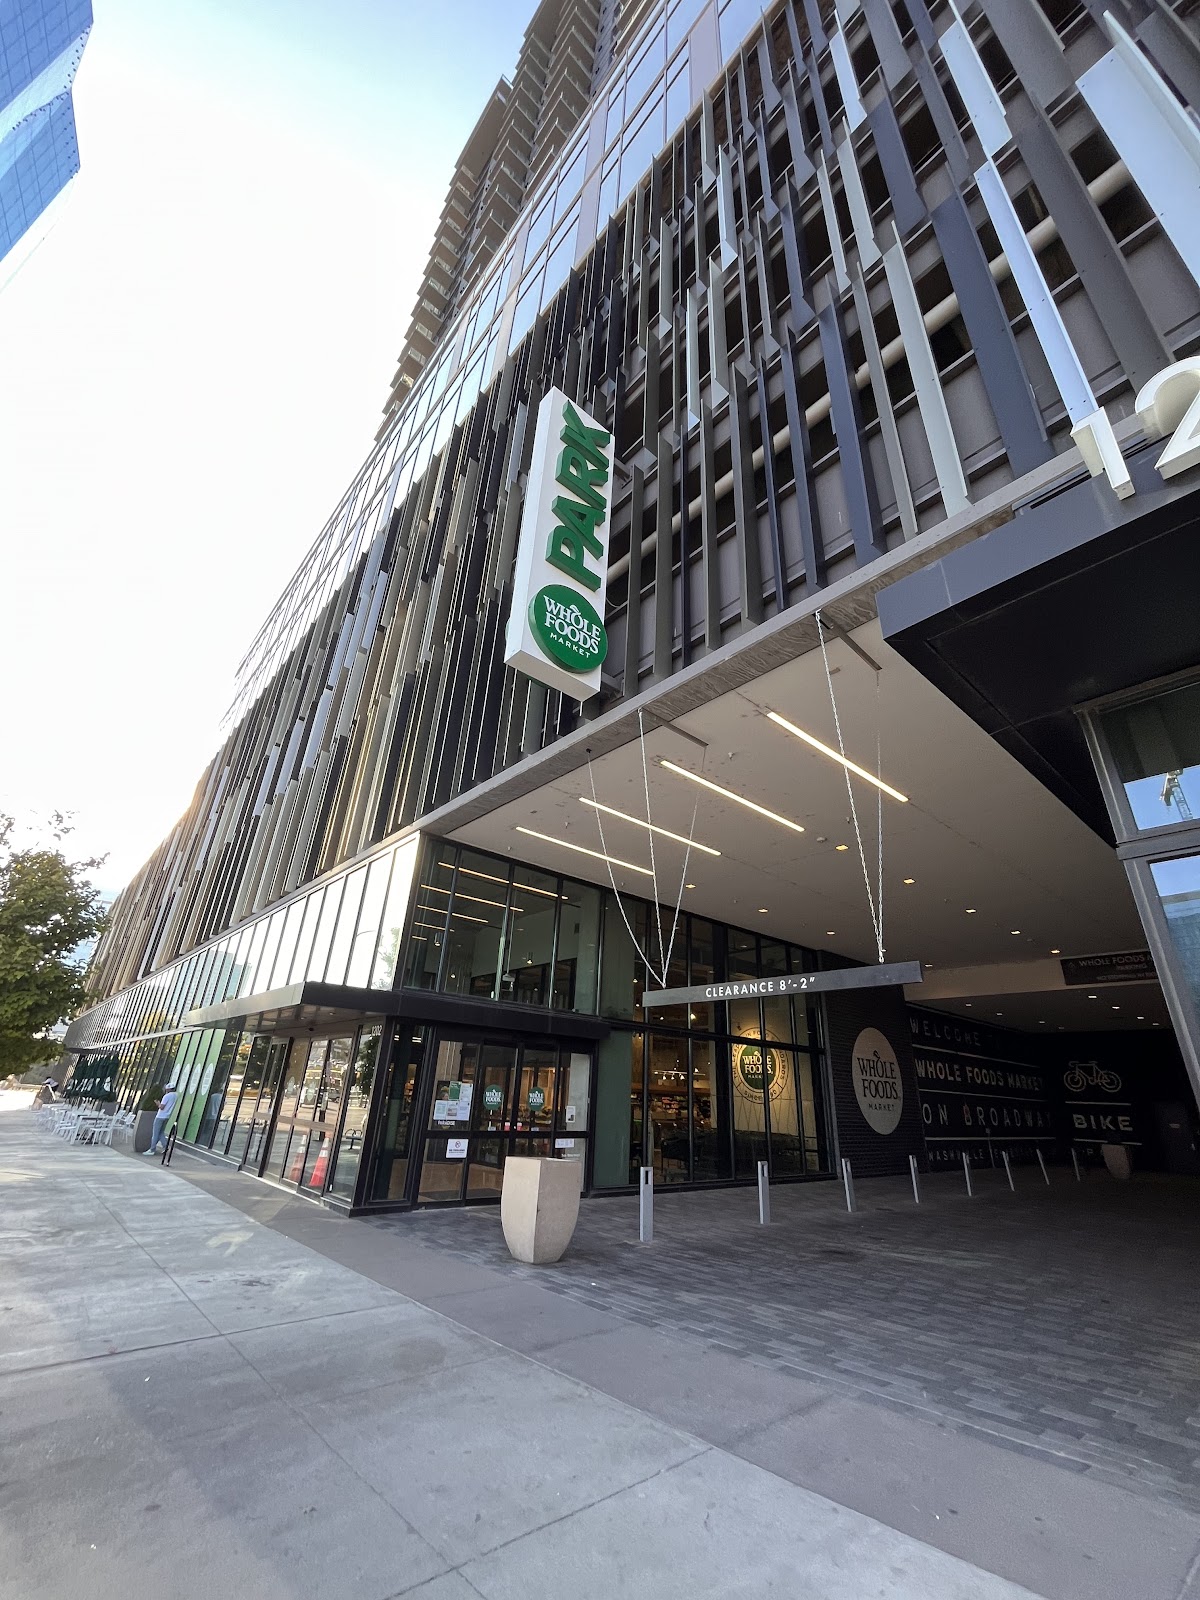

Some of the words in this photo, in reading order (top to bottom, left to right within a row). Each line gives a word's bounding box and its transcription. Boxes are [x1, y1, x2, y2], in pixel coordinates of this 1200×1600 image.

[545, 399, 611, 592] PARK
[543, 595, 601, 641] WHOLE
[544, 611, 599, 654] FOODS
[550, 632, 591, 659] MARKET
[1079, 958, 1111, 967] WHOLE
[1112, 954, 1145, 965] FOODS
[705, 981, 774, 998] CLEARANCE
[909, 1016, 981, 1047] WELCOME
[742, 1055, 772, 1065] WHOE
[856, 1056, 897, 1079] WHOLE
[914, 1058, 962, 1082] WHOLE
[965, 1065, 1004, 1086] FOODS
[1006, 1072, 1044, 1092] MARKET
[861, 1079, 898, 1099] FOODS
[922, 1103, 949, 1125] ON
[962, 1103, 1051, 1127] BROADWAY
[1072, 1114, 1133, 1131] BIKE
